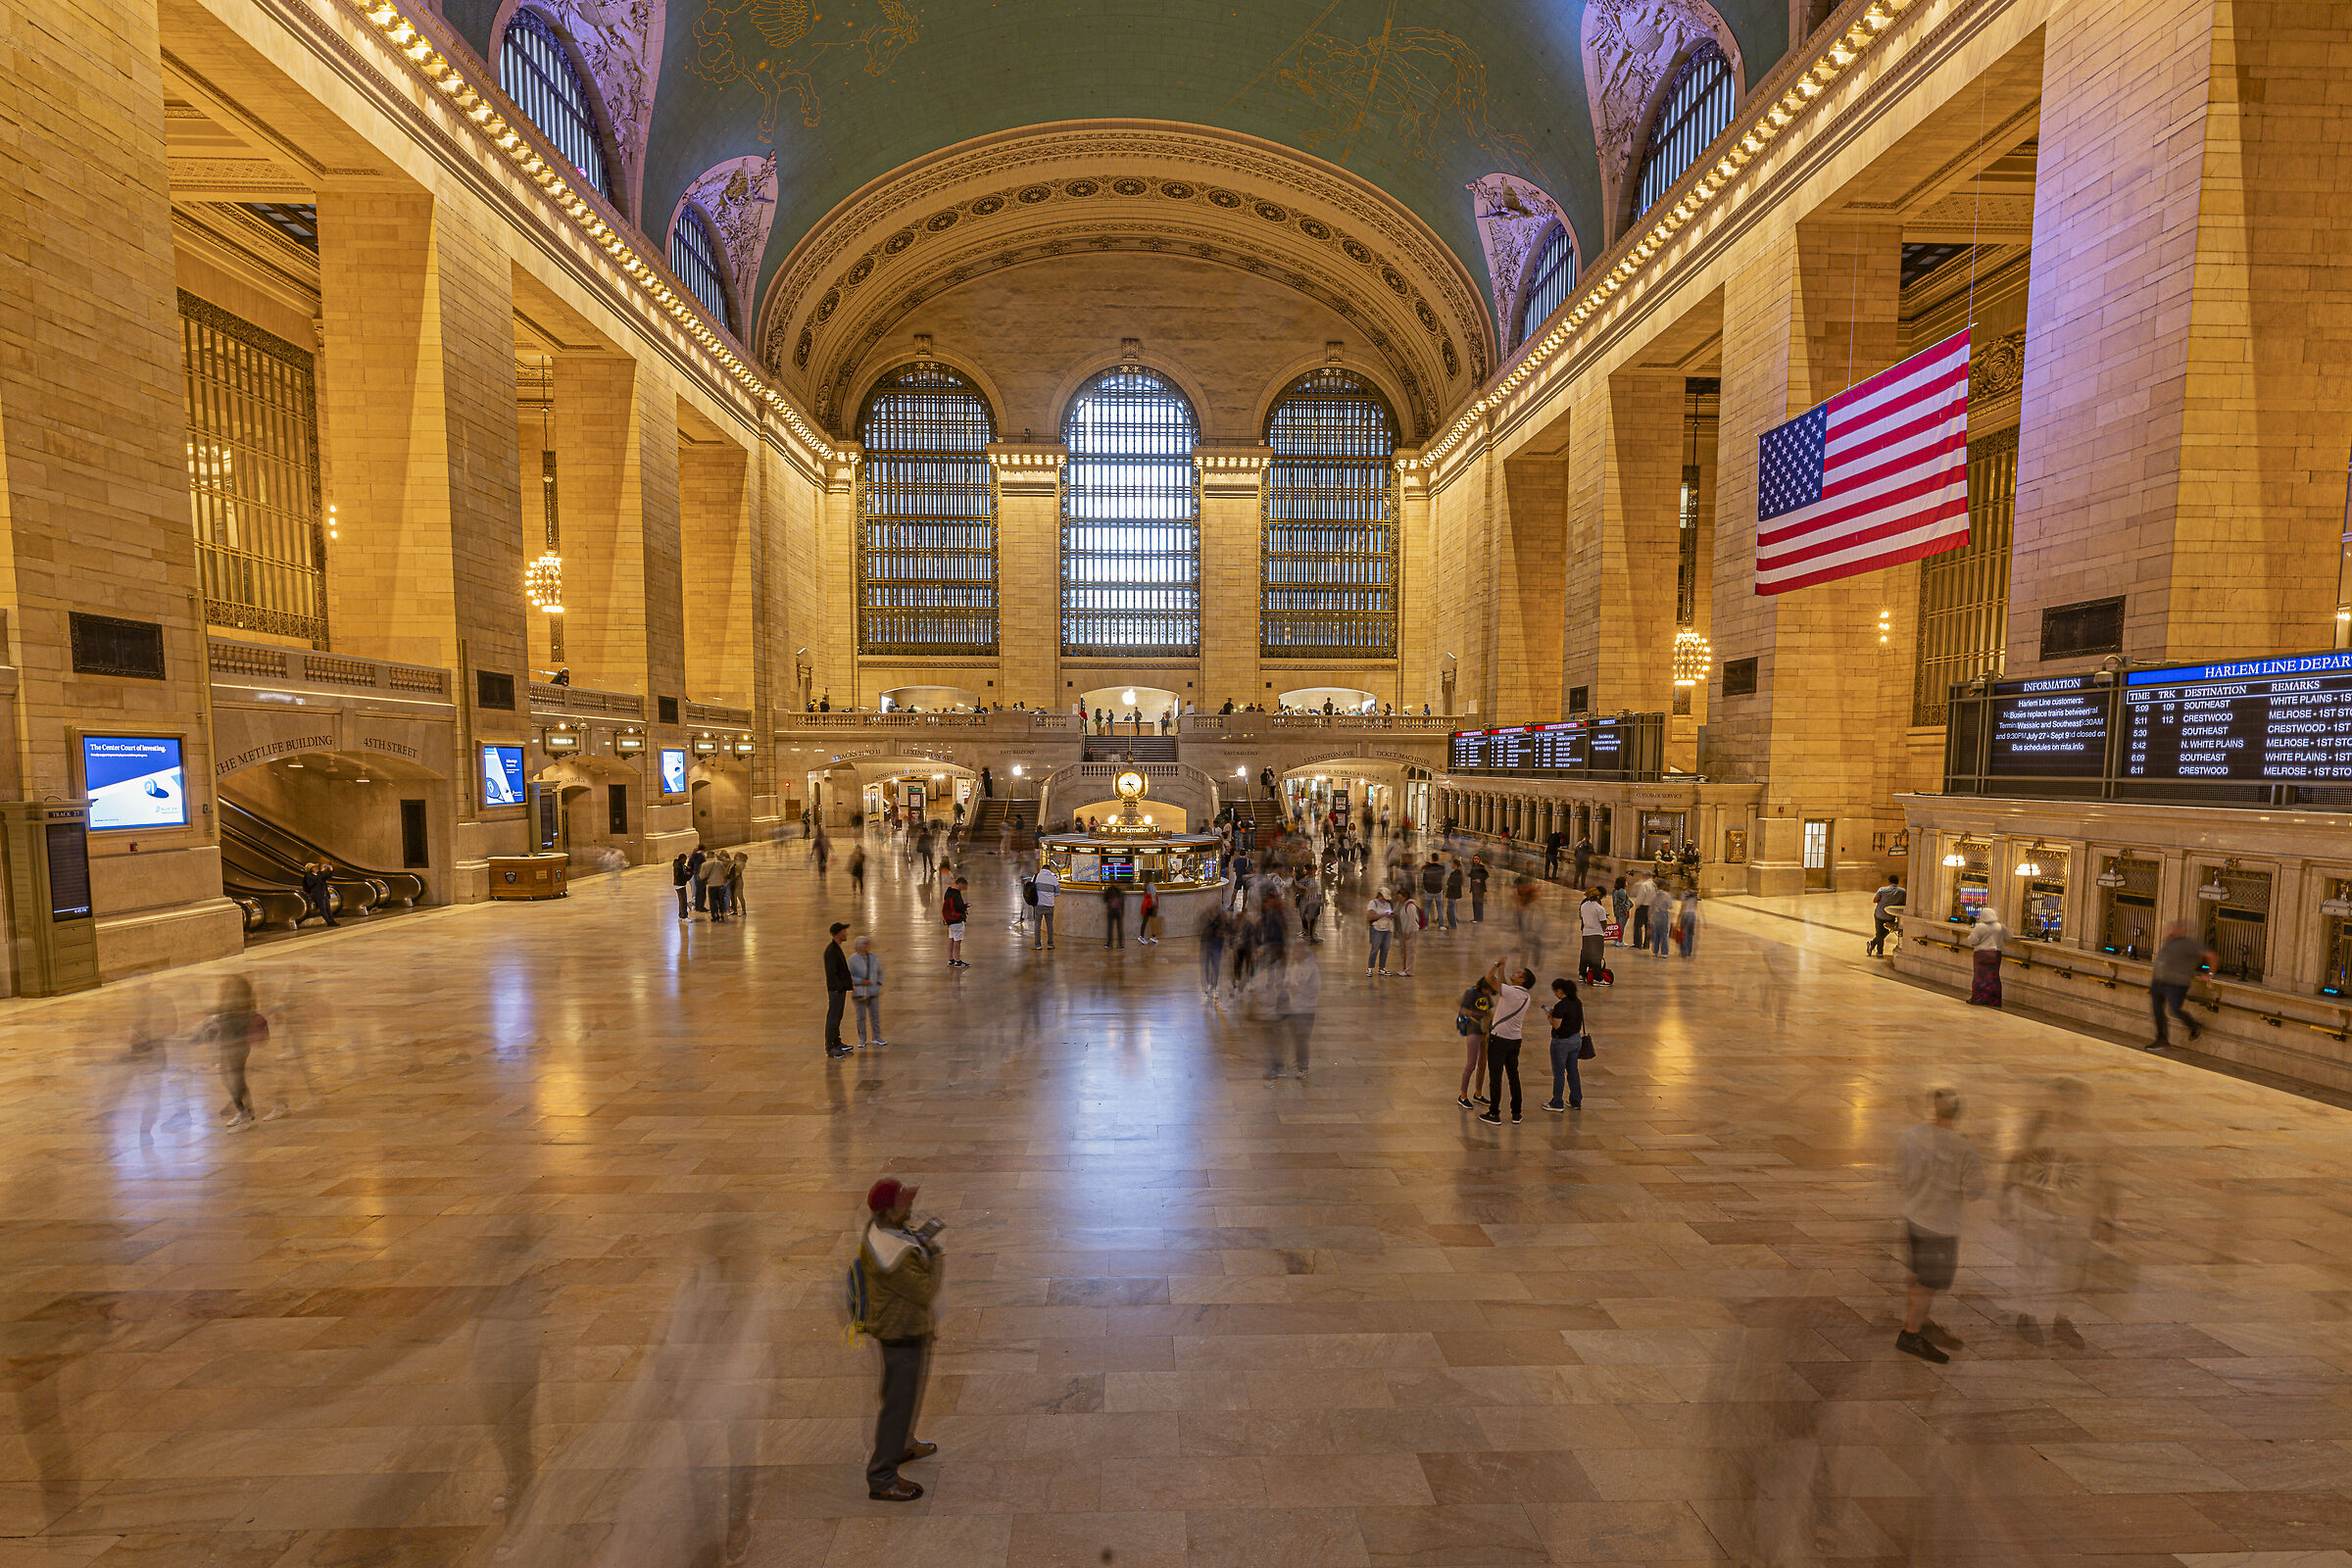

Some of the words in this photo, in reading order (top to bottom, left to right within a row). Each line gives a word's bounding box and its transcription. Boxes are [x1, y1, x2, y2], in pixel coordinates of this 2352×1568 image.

[2205, 662, 2260, 678] HARLEM
[2263, 661, 2297, 674] LINE
[2300, 655, 2352, 671] DEPAR
[2024, 678, 2081, 692] INFORMATION
[2130, 692, 2151, 701] TIME
[2158, 690, 2176, 700] TRK
[2184, 685, 2247, 698] DESTINATION
[2271, 680, 2321, 692] REMARKS
[2019, 699, 2038, 708] Harlem
[2051, 697, 2084, 706] customers:
[2183, 700, 2230, 710] SOUTHEAST
[2270, 695, 2298, 706] WHITE
[2299, 694, 2332, 705] PLAINS
[2339, 693, 2352, 703] 1S
[2027, 710, 2048, 719] replace
[2048, 709, 2064, 717] trains
[2065, 708, 2090, 716] between
[2162, 715, 2174, 724] 112
[2182, 712, 2233, 723] CRESTWOOD
[2268, 710, 2312, 719] MELROSE
[2319, 709, 2336, 718] 1ST
[2052, 719, 2082, 728] Southeast
[2181, 726, 2229, 736] SOUTHEAST
[2267, 724, 2327, 734] CRESTWOOD
[2333, 722, 2351, 732] 1ST
[2050, 732, 2065, 741] Sept
[364, 737, 385, 750] 45TH
[386, 742, 418, 759] STREET
[2180, 740, 2189, 749] N.
[2189, 740, 2215, 749] WHITE
[2215, 739, 2244, 749] PLAINS
[2266, 738, 2310, 748] MELROSE
[2317, 738, 2334, 747] 1ST
[216, 758, 237, 776] THE
[237, 742, 284, 764] METLIFE
[285, 735, 333, 752] BUILDING
[903, 749, 941, 759] LEXINGTON
[1303, 752, 1341, 763] LEXINGTON
[1398, 754, 1431, 764] MACHINES
[2131, 754, 2145, 762] 6:09
[2180, 754, 2227, 762] SOUTHEAST
[2265, 753, 2293, 762] WHITE
[2294, 753, 2328, 762] PLAINS
[2334, 753, 2352, 761] 1ST
[2179, 766, 2229, 775] CRESTWOOD
[2264, 766, 2307, 776] MELROSE
[2314, 767, 2331, 776] 1ST
